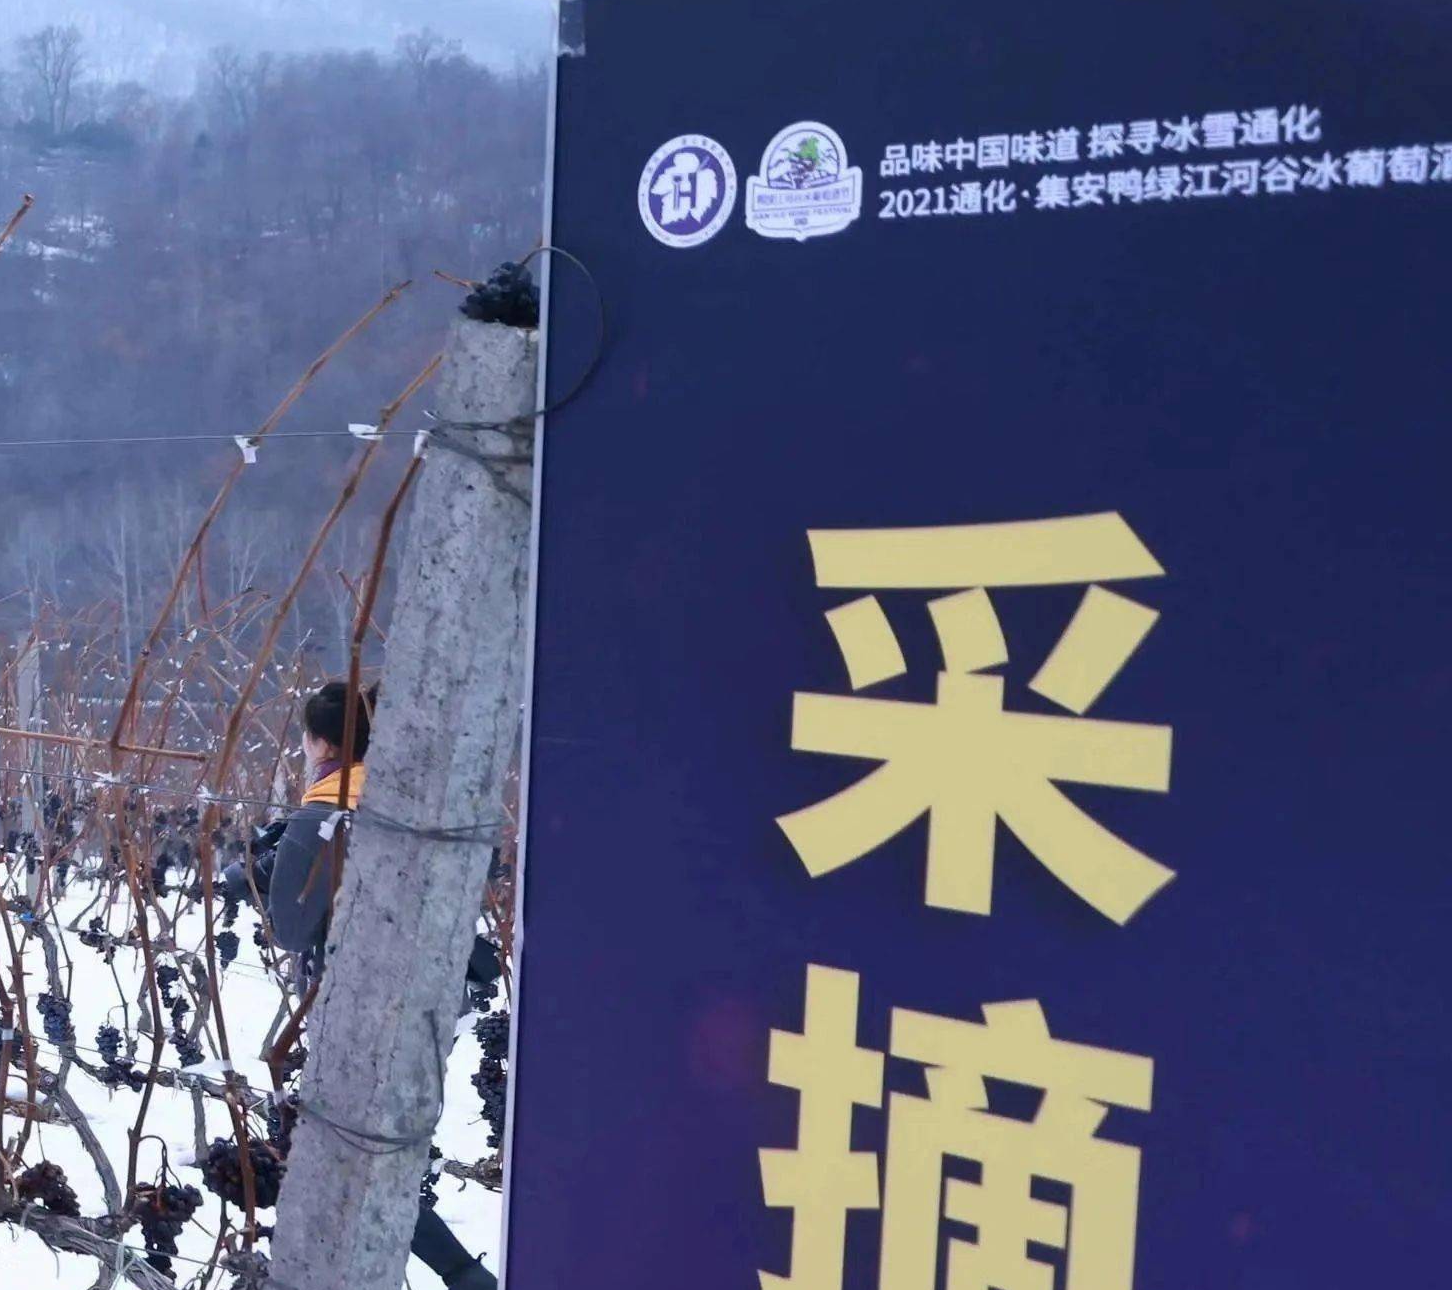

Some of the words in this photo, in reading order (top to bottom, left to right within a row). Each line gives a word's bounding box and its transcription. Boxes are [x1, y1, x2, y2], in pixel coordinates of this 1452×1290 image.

[879, 126, 1081, 177] 品味中国味道
[1087, 104, 1322, 158] 探寻冰雪通化
